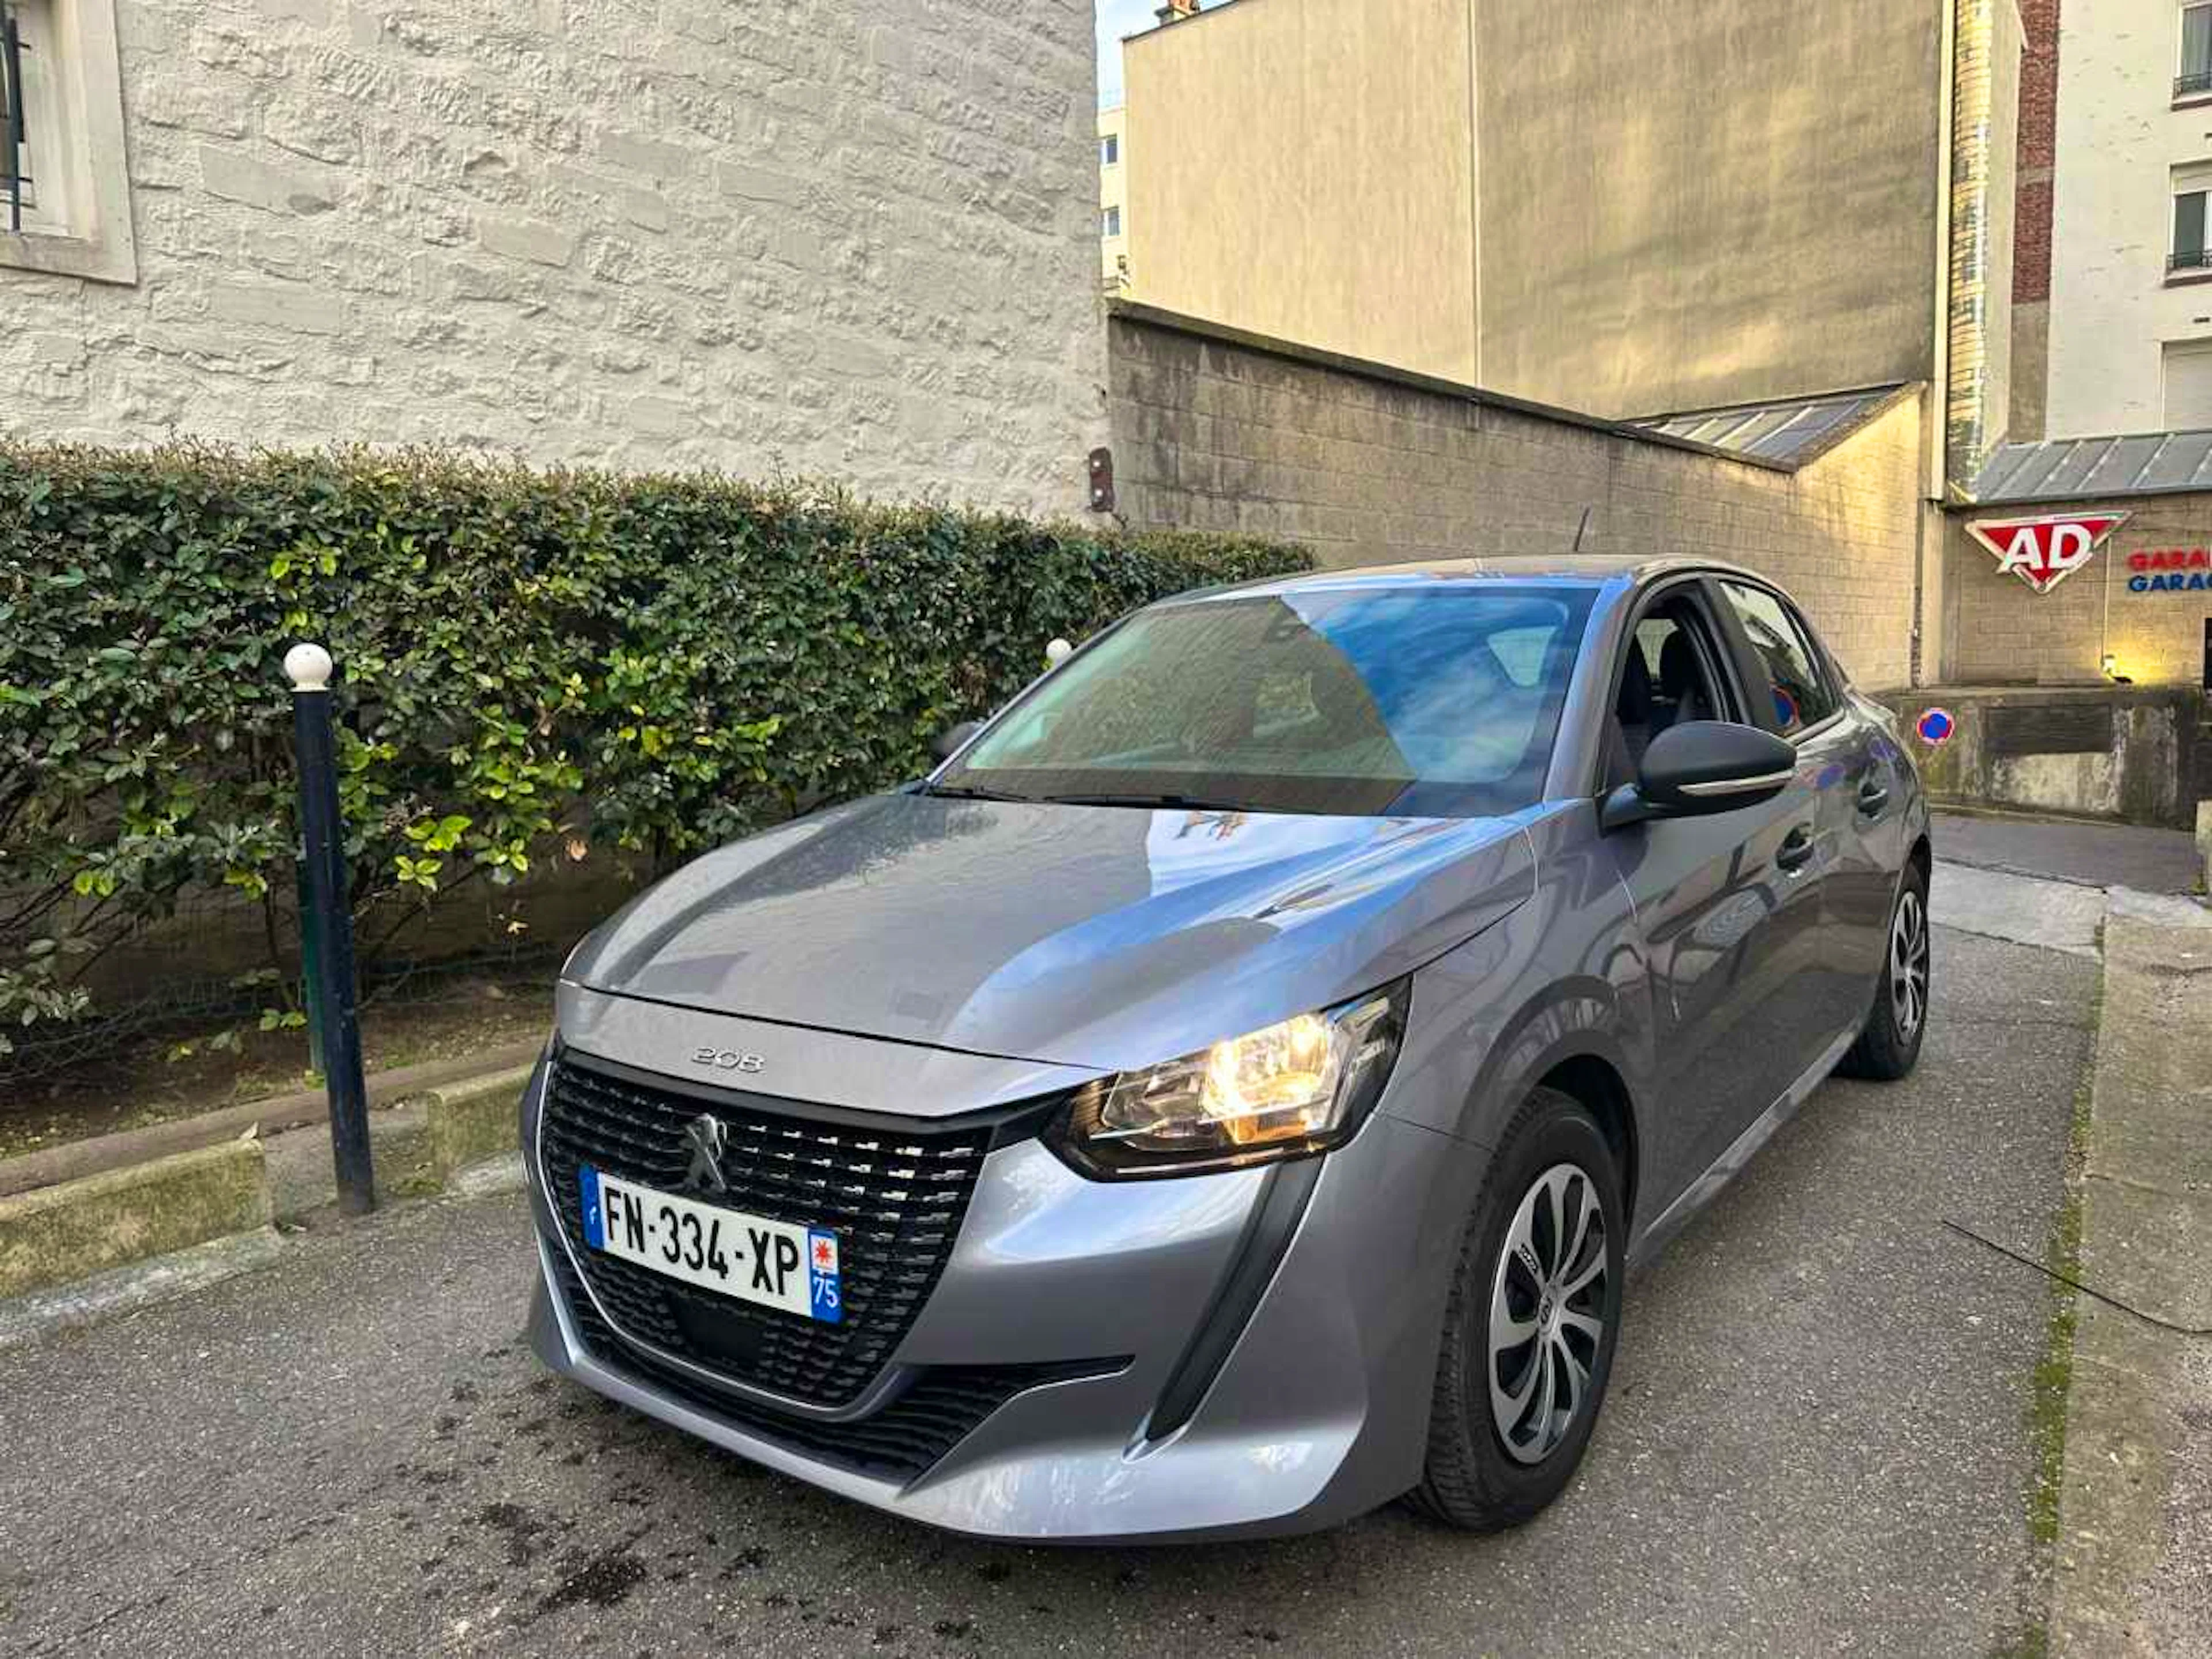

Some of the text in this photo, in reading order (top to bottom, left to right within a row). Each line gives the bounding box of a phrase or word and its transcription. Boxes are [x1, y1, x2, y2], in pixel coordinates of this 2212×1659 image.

[1996, 523, 2093, 574] AD
[2126, 549, 2212, 571] GARA
[691, 1047, 766, 1073] 208
[605, 1187, 799, 1296] FN-334-XP
[812, 1277, 839, 1309] 75
